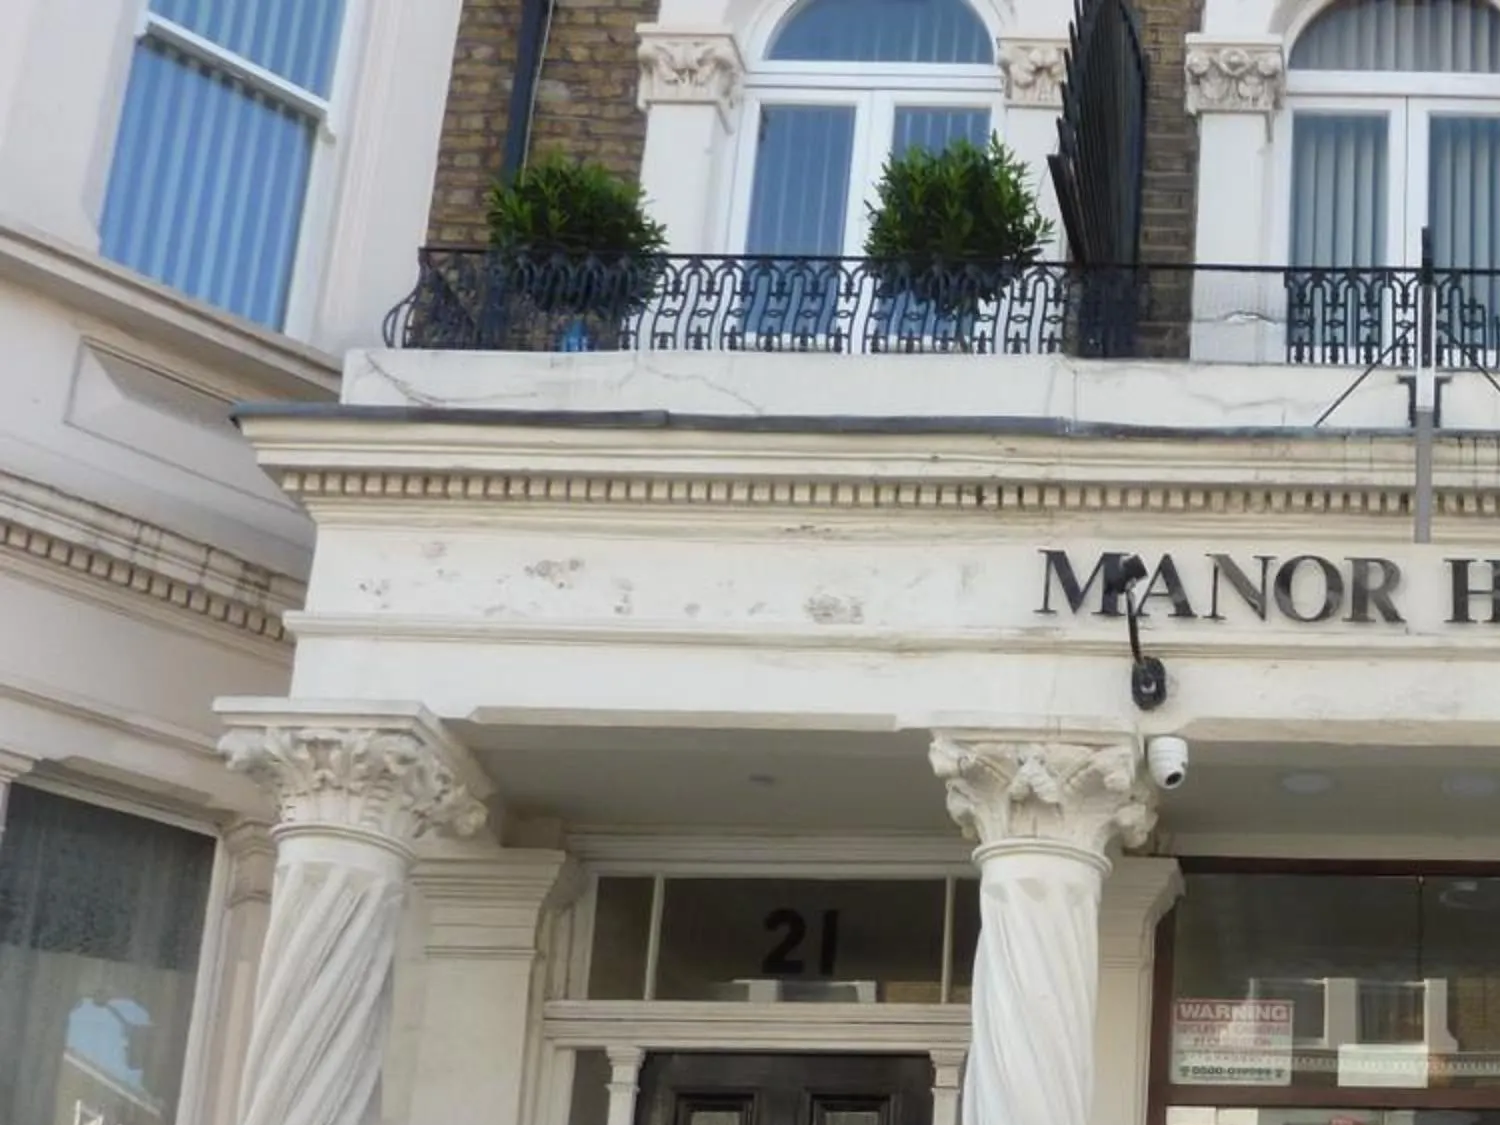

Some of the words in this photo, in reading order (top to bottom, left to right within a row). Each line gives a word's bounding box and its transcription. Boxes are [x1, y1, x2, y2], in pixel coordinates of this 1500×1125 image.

[1032, 548, 1407, 625] MANOR
[761, 907, 840, 976] 21
[1179, 1002, 1289, 1022] WARNING
